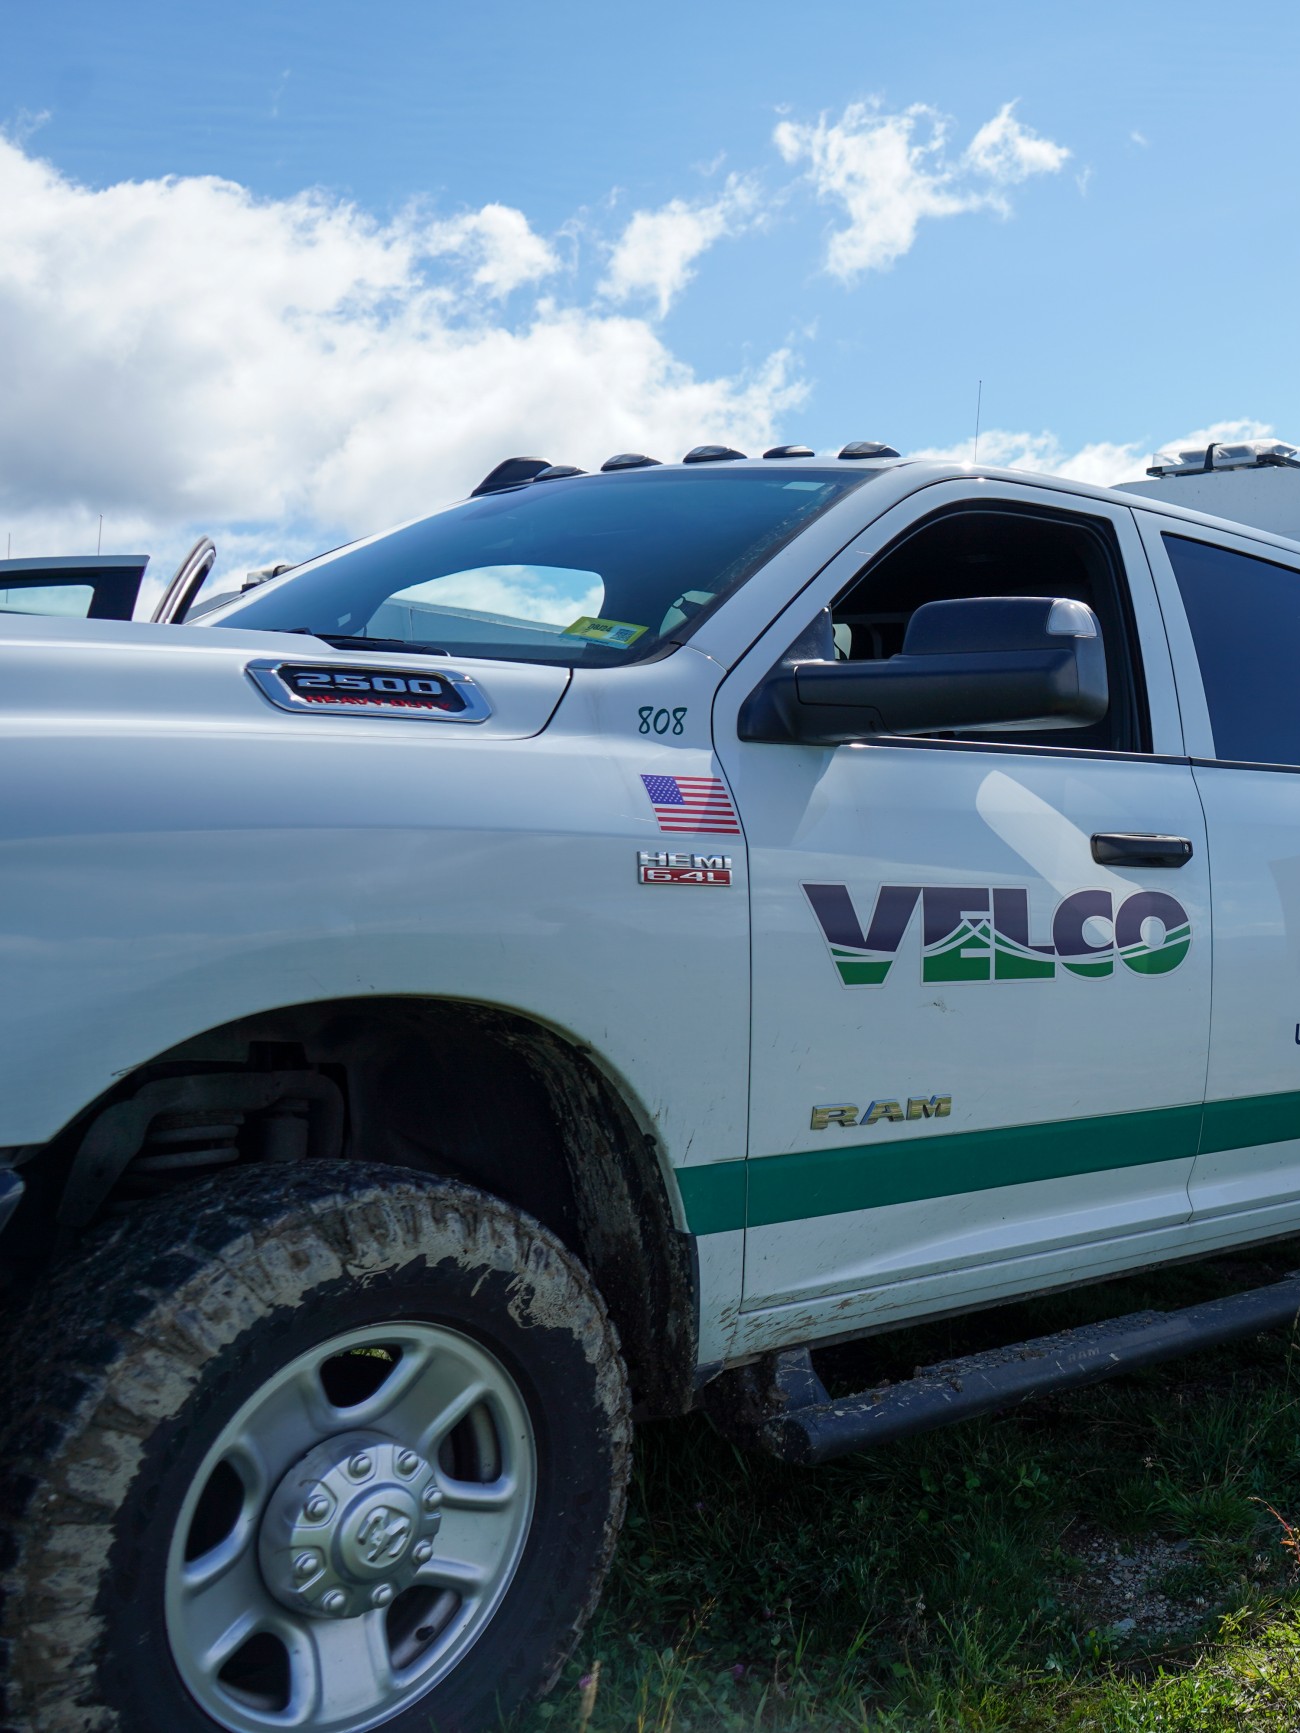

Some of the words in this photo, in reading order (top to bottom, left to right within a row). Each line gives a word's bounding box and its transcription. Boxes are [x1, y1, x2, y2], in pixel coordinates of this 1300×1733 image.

[293, 672, 443, 695] 2500
[638, 706, 687, 735] 808
[637, 851, 732, 869] HEMI
[647, 869, 727, 882] 6.4L
[801, 883, 1192, 986] VELCO
[810, 1094, 952, 1130] RAM
